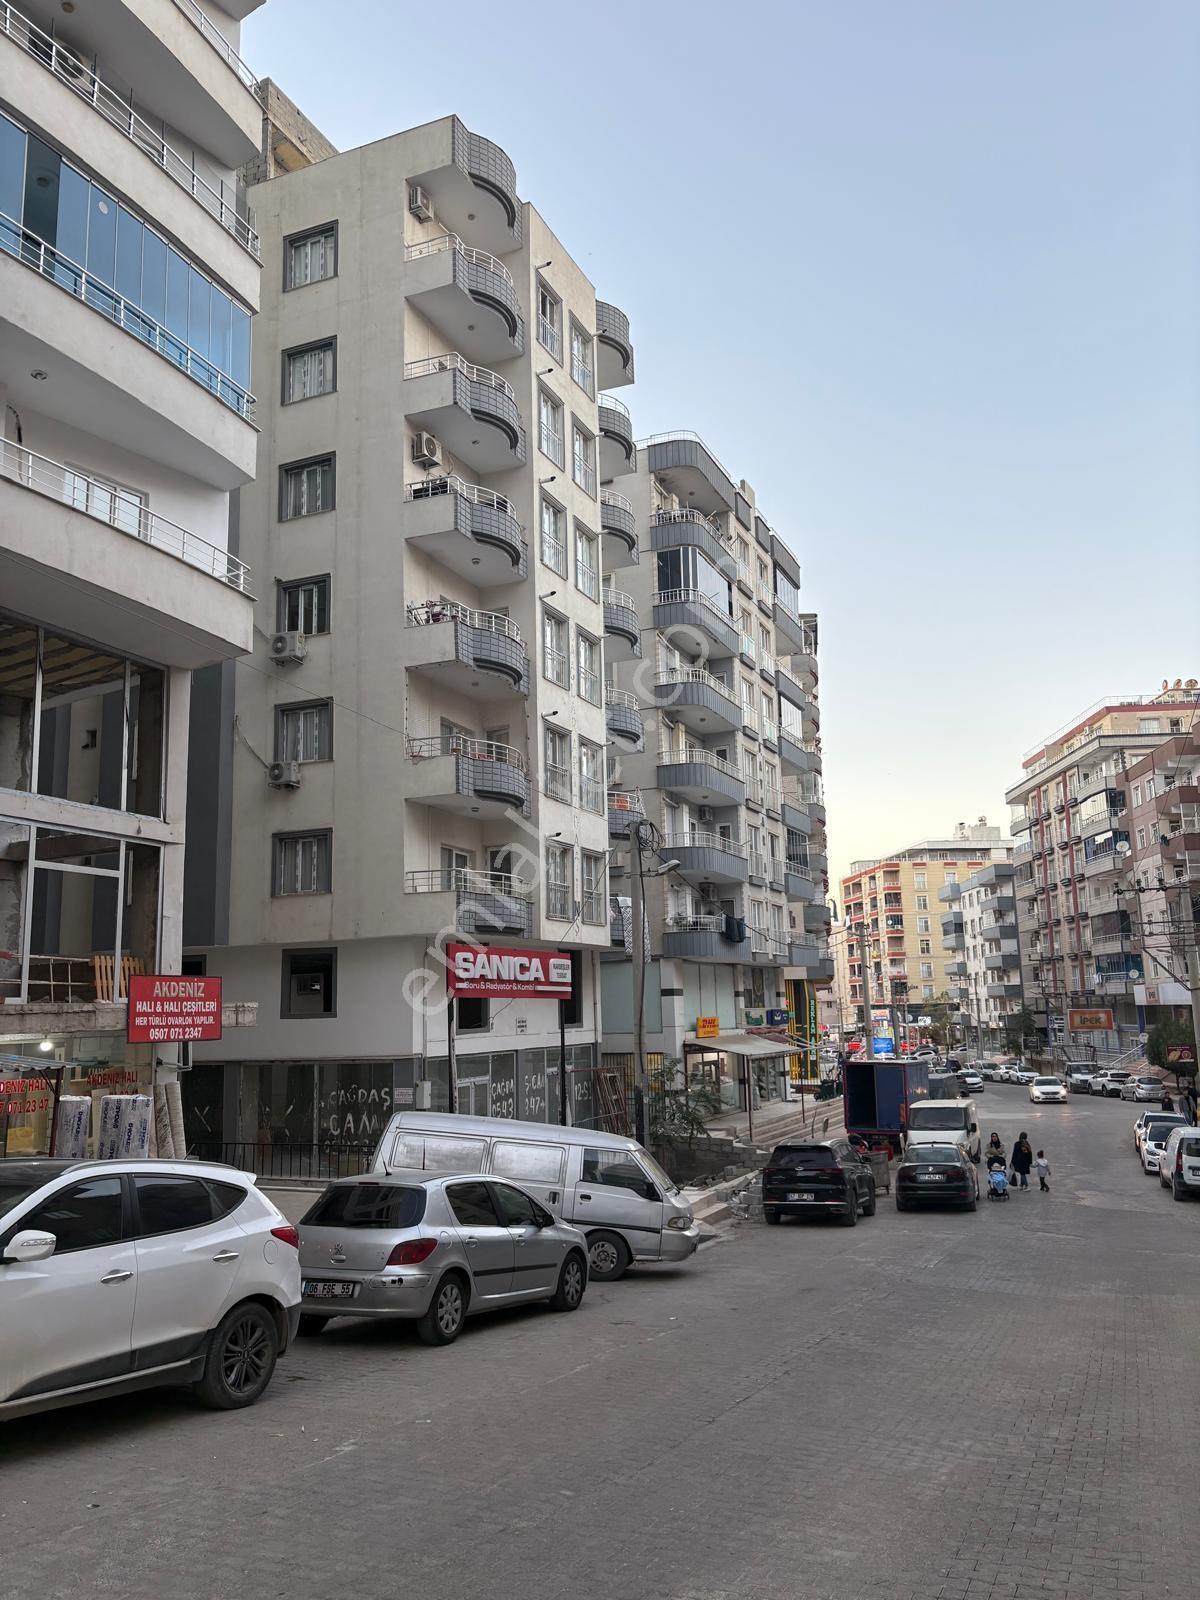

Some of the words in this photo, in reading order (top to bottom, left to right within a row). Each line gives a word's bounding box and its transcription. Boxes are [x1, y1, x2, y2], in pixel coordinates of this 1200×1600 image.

[455, 952, 545, 982] SANICA
[153, 978, 205, 997] AKDENİZ
[136, 1001, 154, 1013] HALI
[156, 1001, 162, 1012] &
[164, 1001, 180, 1013] HALI
[182, 998, 217, 1015] ÇEŞİTLERİ
[135, 1016, 148, 1026] HER
[149, 1015, 167, 1026] TÜRLÜ
[167, 1016, 192, 1025] OVARLOK
[149, 1028, 168, 1040] 0507
[170, 1028, 183, 1039] 071
[184, 1027, 203, 1039] 2347
